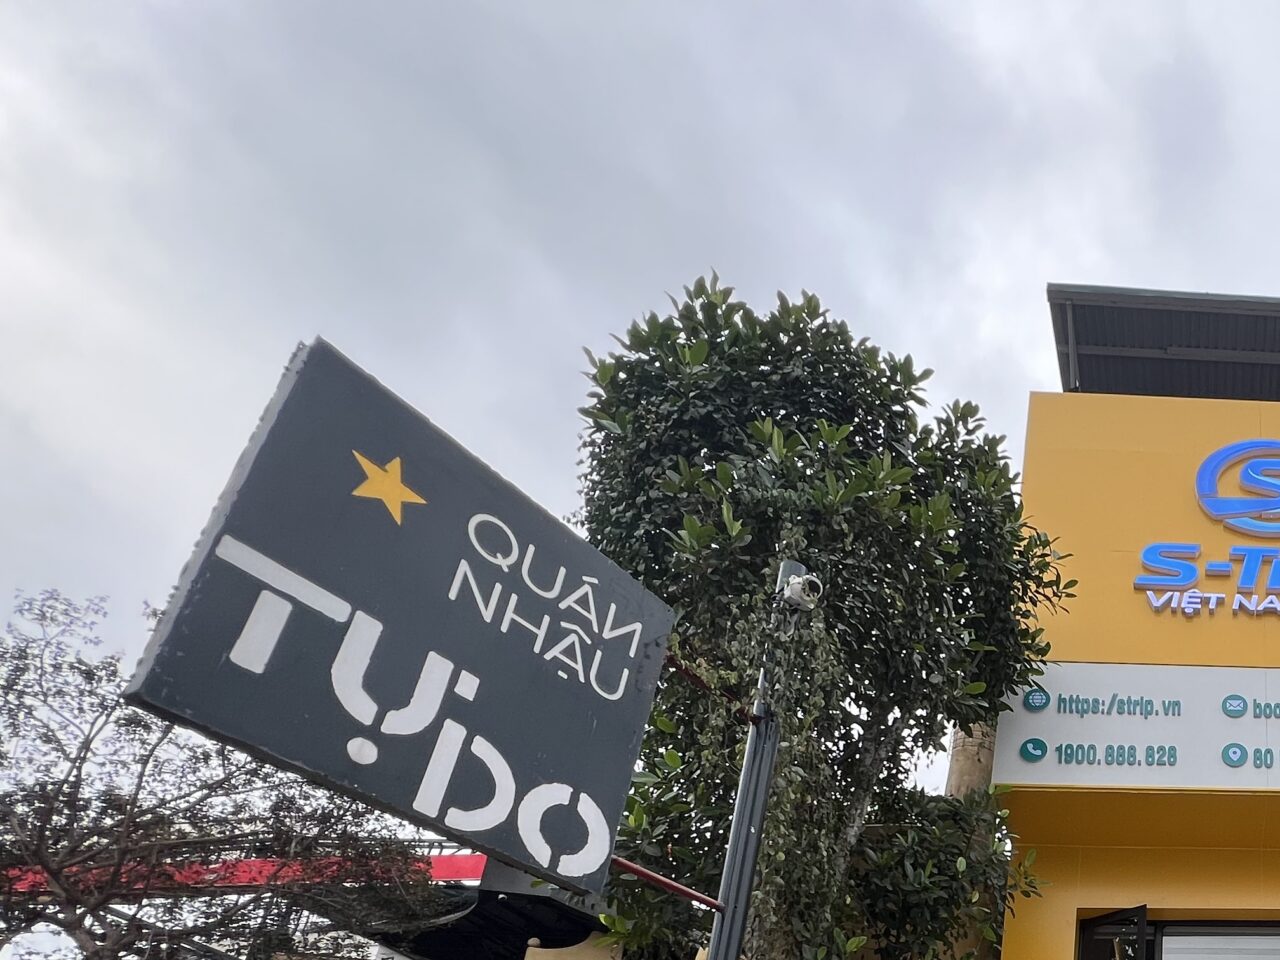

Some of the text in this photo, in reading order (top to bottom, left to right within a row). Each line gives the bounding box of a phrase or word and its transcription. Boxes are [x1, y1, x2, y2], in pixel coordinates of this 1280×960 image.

[216, 534, 480, 765] TỰ
[448, 559, 630, 700] NHẬU
[468, 514, 642, 657] QUÁN
[1145, 589, 1226, 618] VIỆT
[413, 718, 611, 877] DO
[1055, 743, 1178, 767] 1900.888.828
[1253, 747, 1274, 769] 80
